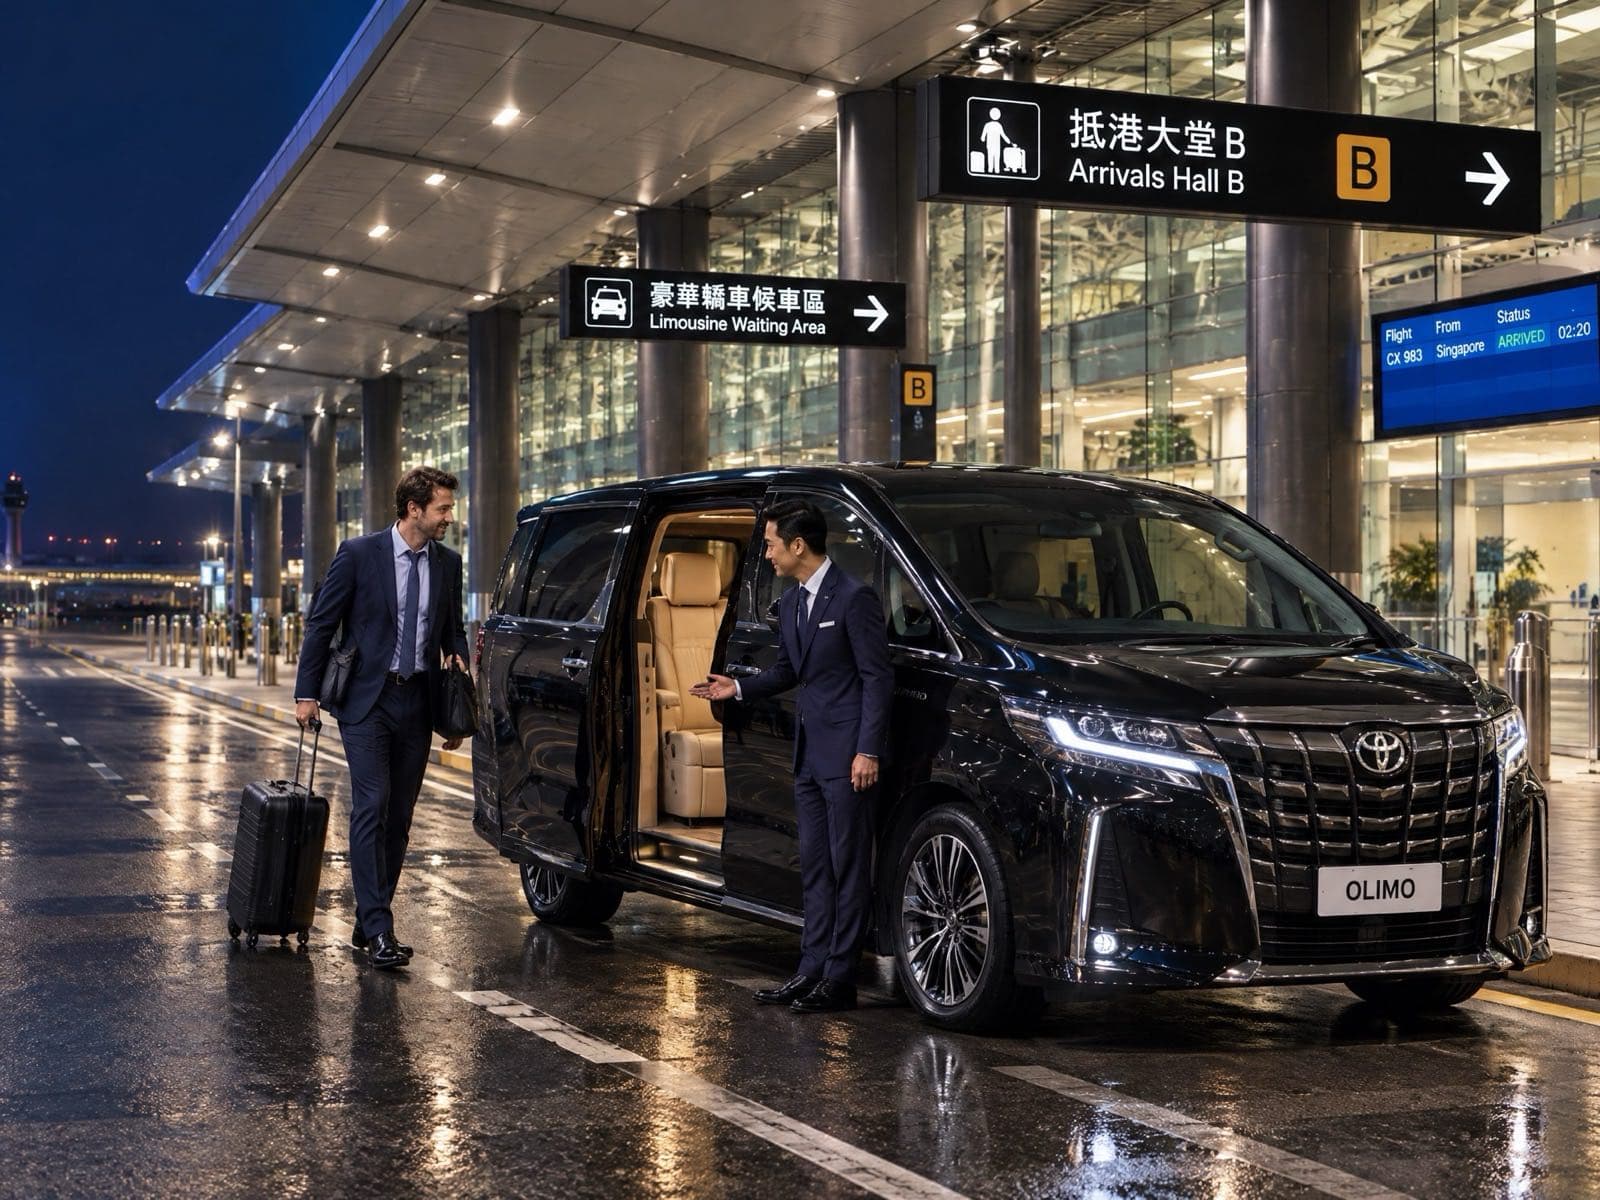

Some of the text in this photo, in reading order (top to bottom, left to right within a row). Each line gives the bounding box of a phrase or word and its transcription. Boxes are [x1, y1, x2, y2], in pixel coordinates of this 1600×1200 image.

[1069, 107, 1246, 160] 抵港大堂 B
[1068, 158, 1245, 194] Arrivals Hall B
[1351, 146, 1378, 190] B
[650, 281, 826, 315] 豪華轎車候車區
[650, 313, 826, 336] Limousine Waiting Area
[1385, 308, 1531, 344] Flight From Status
[1386, 321, 1591, 366] CX 983 Singapore ARRIVED 02:20
[911, 377, 926, 400] B
[1345, 878, 1416, 901] OLIMO
